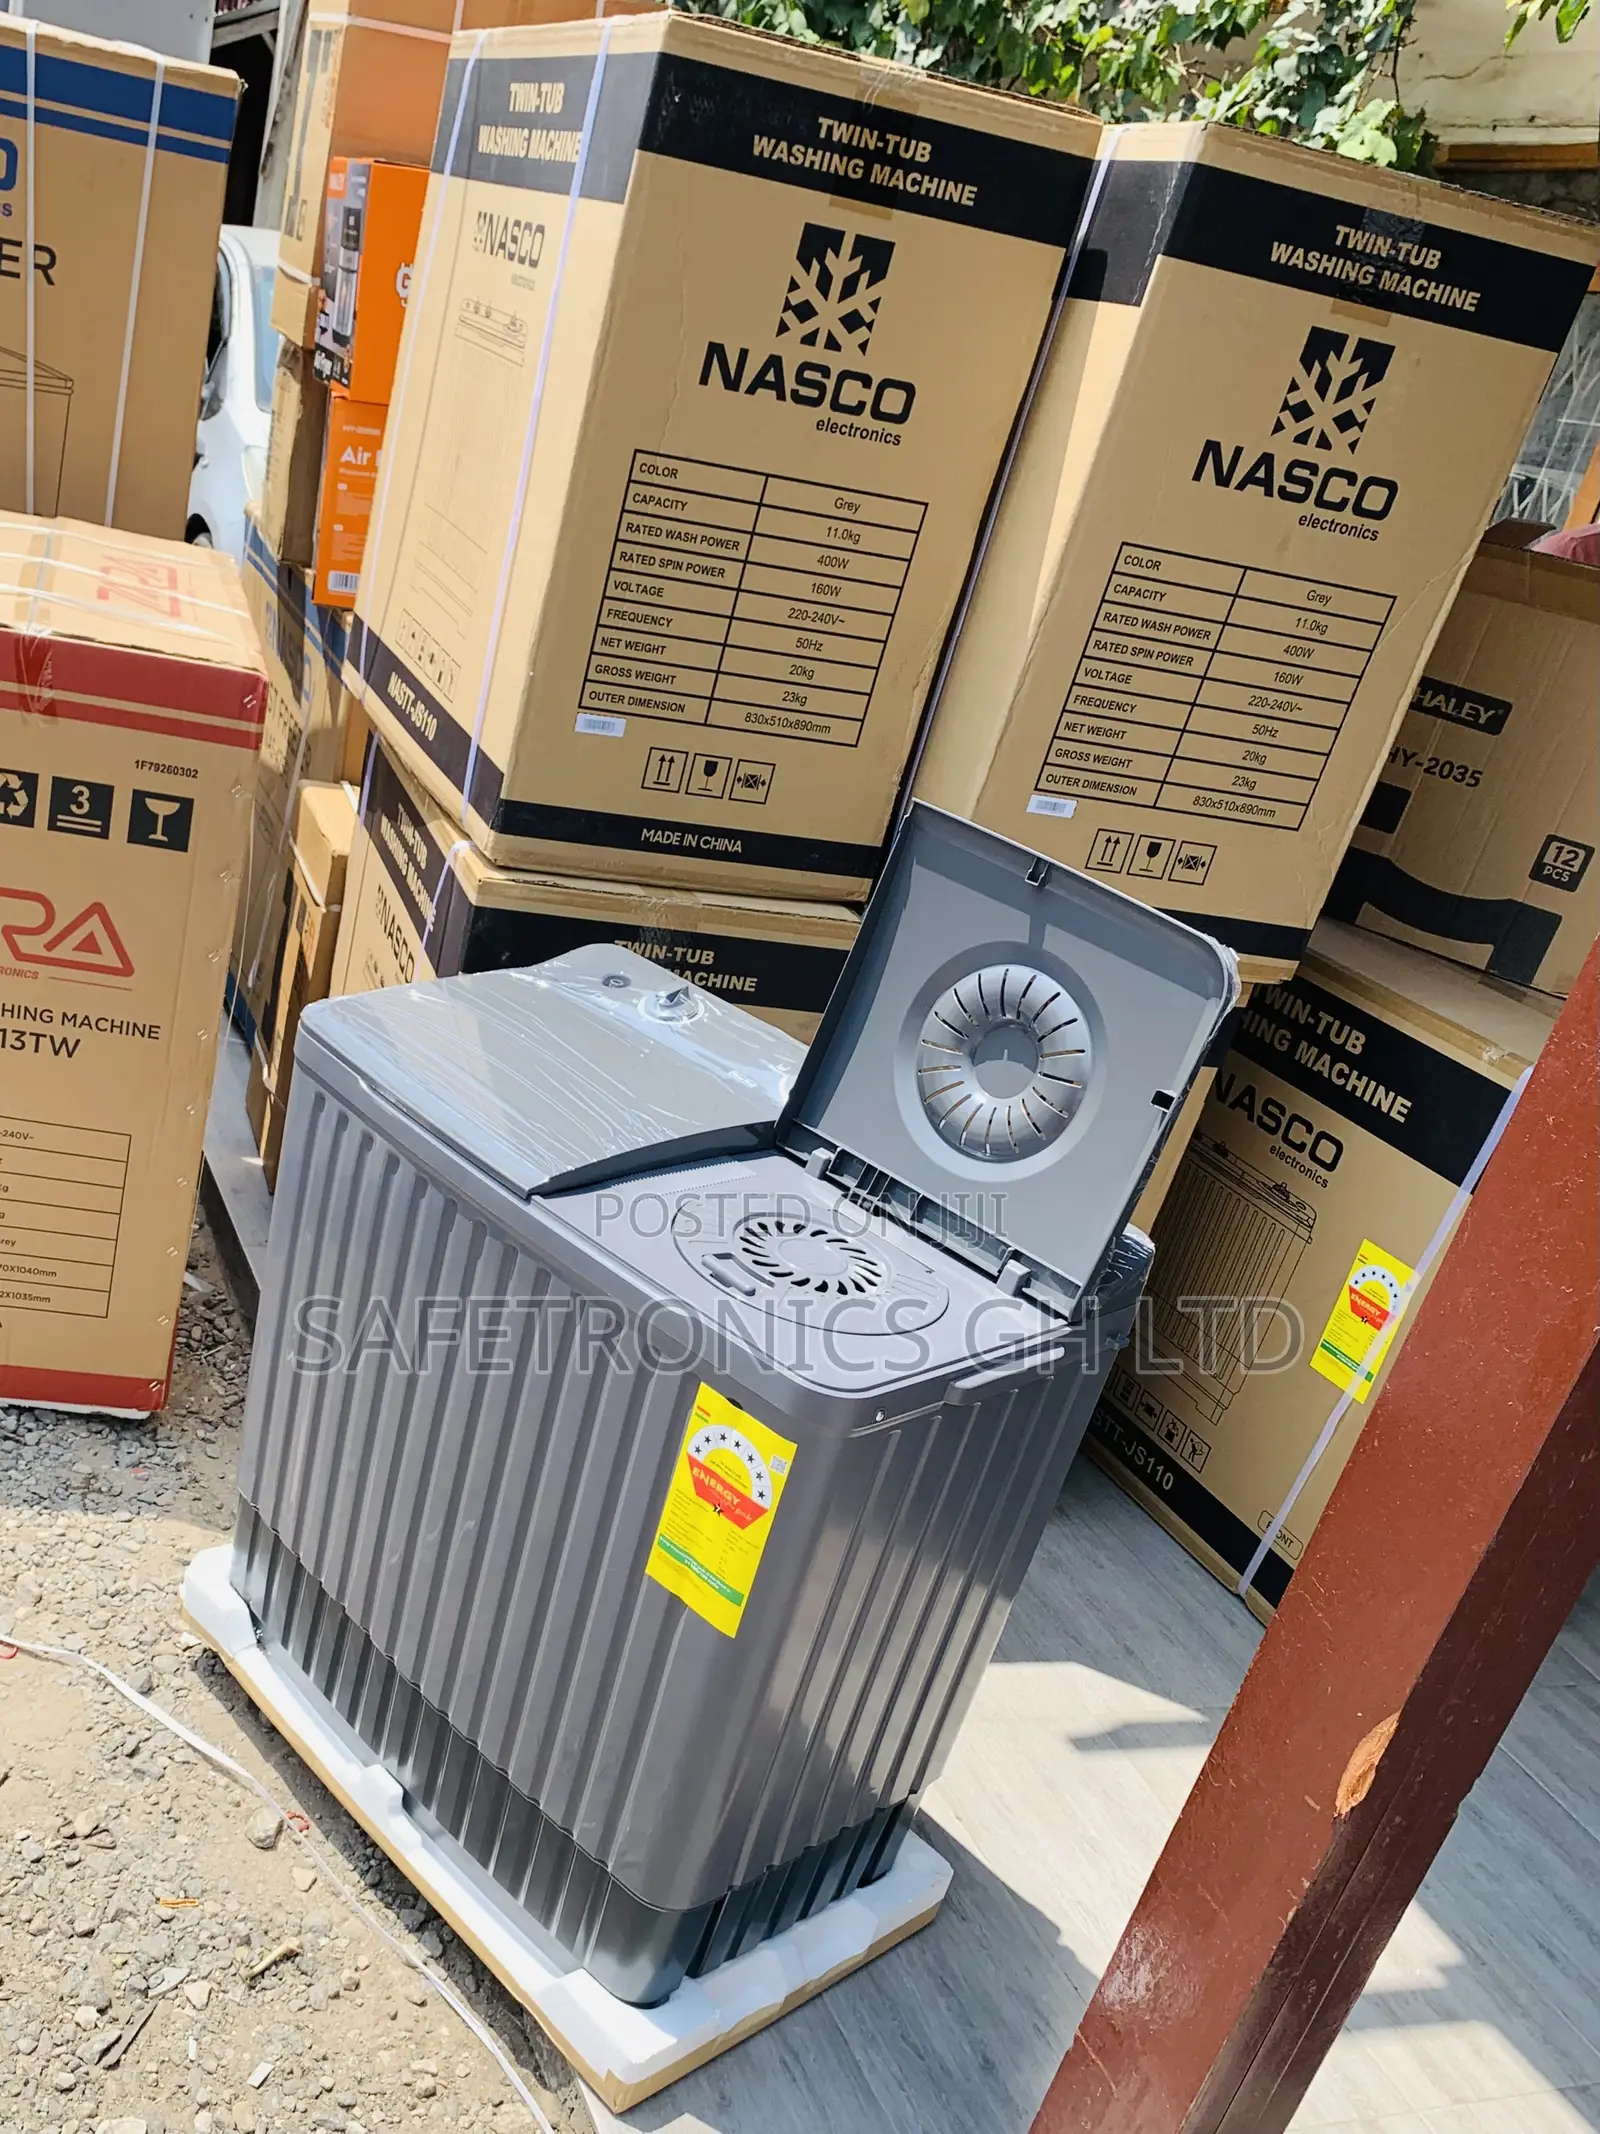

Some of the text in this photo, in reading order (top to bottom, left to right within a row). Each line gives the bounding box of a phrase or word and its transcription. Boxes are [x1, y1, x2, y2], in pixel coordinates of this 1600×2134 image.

[509, 83, 565, 113] TWIN-TUB
[478, 125, 529, 158] WASHING
[817, 116, 932, 163] TWIN-TUB
[753, 134, 978, 207] WASHING MACHINE
[483, 212, 545, 269] NASCO
[1335, 225, 1441, 270] TWIN-TUB
[1270, 241, 1481, 312] WASHING MACHINE
[699, 341, 916, 424] NASCO
[816, 417, 901, 446] electronics
[340, 445, 372, 465] Air
[639, 462, 679, 480] COLOR
[1191, 439, 1398, 521] NASCO
[632, 492, 688, 511] CAPACITY
[834, 497, 860, 514] Grey
[625, 522, 740, 551] RATED WASH POWER
[826, 526, 861, 545] 11.0kg
[1299, 513, 1379, 541] electronics
[619, 551, 725, 578] RATED SPIN POWER
[817, 554, 849, 570] 400W
[1123, 555, 1162, 571] COLOR
[613, 580, 665, 597] VOLTAGE
[811, 582, 841, 598] 160W
[1113, 583, 1166, 602] CAPACITY
[1306, 589, 1332, 607] Grey
[607, 608, 673, 628] FREQUENCY
[1103, 611, 1211, 641] RATED WASH POWER
[1295, 616, 1329, 635] 11.0kg
[600, 636, 666, 655] NET WEIGHT
[795, 637, 823, 652] 50Hz
[1092, 639, 1194, 667] RATED SPIN POWER
[1283, 644, 1314, 660] 400W
[594, 663, 676, 685] GROSS WEIGHT
[789, 664, 815, 680] 20kg
[1083, 668, 1132, 685] VOLTAGE
[1274, 671, 1304, 686] 160W
[588, 690, 685, 713] OUTER DIMENSION
[782, 690, 807, 706] 23kg
[1073, 694, 1137, 714] FREQUENCY
[744, 712, 831, 734] 830x510x890mm
[1064, 721, 1127, 740] NET WEIGHT
[1252, 723, 1279, 738] 50Hz
[1055, 748, 1133, 769] GROSS WEIGHT
[1242, 750, 1267, 765] 20kg
[1045, 774, 1138, 796] OUTER DIMENSION
[1232, 775, 1257, 791] 23kg
[1193, 796, 1276, 818] 830x510x890mm
[380, 813, 408, 876] WASHING
[398, 802, 428, 870] TWIN-TUB
[641, 828, 742, 853] MADE IN CHINA
[1553, 845, 1579, 868] 12
[1543, 866, 1570, 882] PCS
[380, 898, 414, 984] NASCO
[667, 968, 758, 992] ACHINE
[1, 1003, 161, 1040] HING MACHINE
[1294, 1039, 1412, 1123] MACHINE
[1215, 1067, 1344, 1173] NASCO
[1269, 1144, 1329, 1188] electronics
[0, 1237, 17, 1248] rey
[692, 1466, 741, 1506] ENERGY
[1266, 1521, 1294, 1548] FONT
